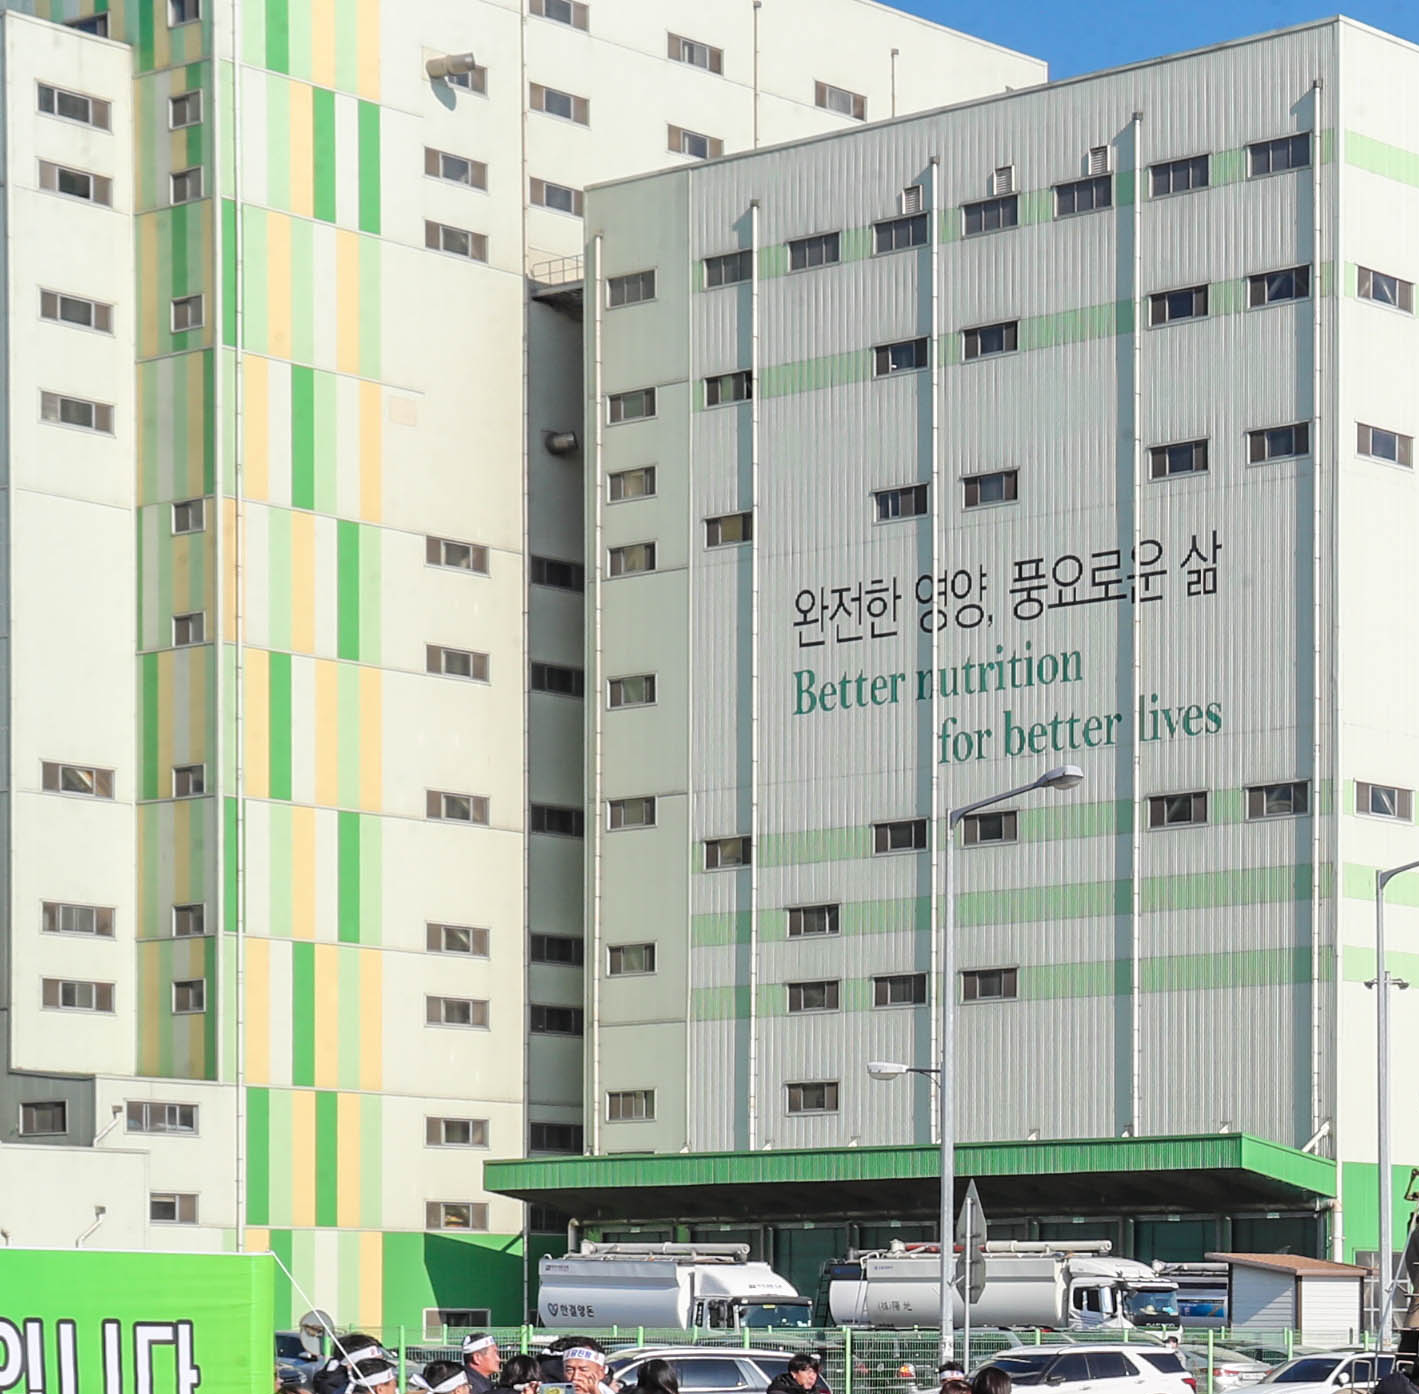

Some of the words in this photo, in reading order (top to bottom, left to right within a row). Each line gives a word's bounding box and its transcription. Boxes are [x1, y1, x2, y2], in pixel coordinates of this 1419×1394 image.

[793, 576, 902, 648] 완전한
[915, 564, 994, 634] 영양,
[1009, 539, 1167, 621] 풍요로운
[1180, 530, 1223, 597] 삶
[792, 668, 906, 715] Better
[916, 640, 1084, 701] nutrition
[937, 716, 993, 764] for
[1003, 709, 1122, 756] better
[1139, 693, 1223, 743] lives
